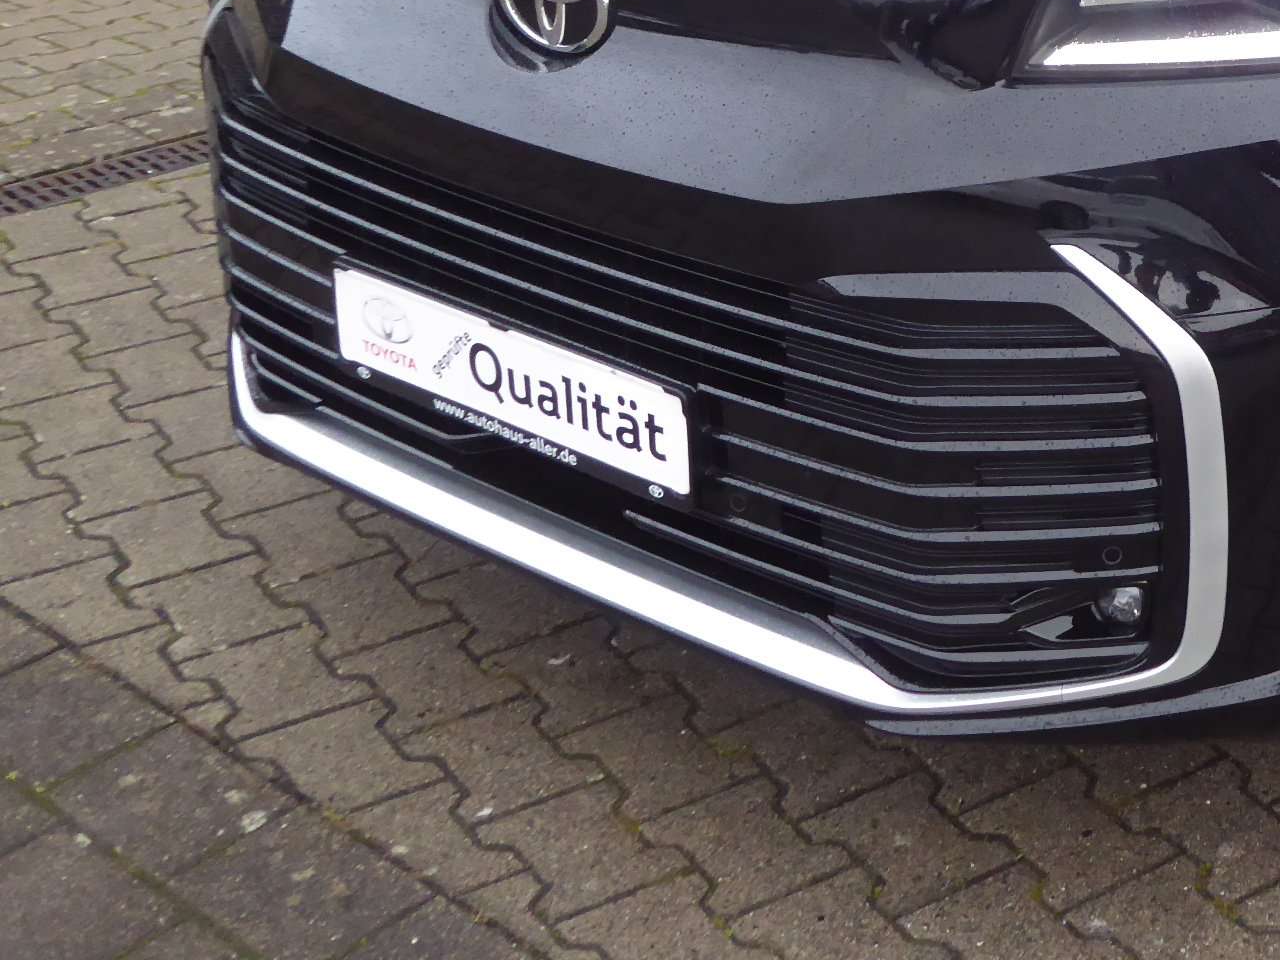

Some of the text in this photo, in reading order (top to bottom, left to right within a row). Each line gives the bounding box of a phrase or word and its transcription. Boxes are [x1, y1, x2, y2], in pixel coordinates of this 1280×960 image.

[362, 339, 417, 370] TOYOTA
[432, 332, 472, 380] geprüfte
[469, 342, 667, 462] Qualität
[432, 398, 577, 466] www.autohaus-aller.de
